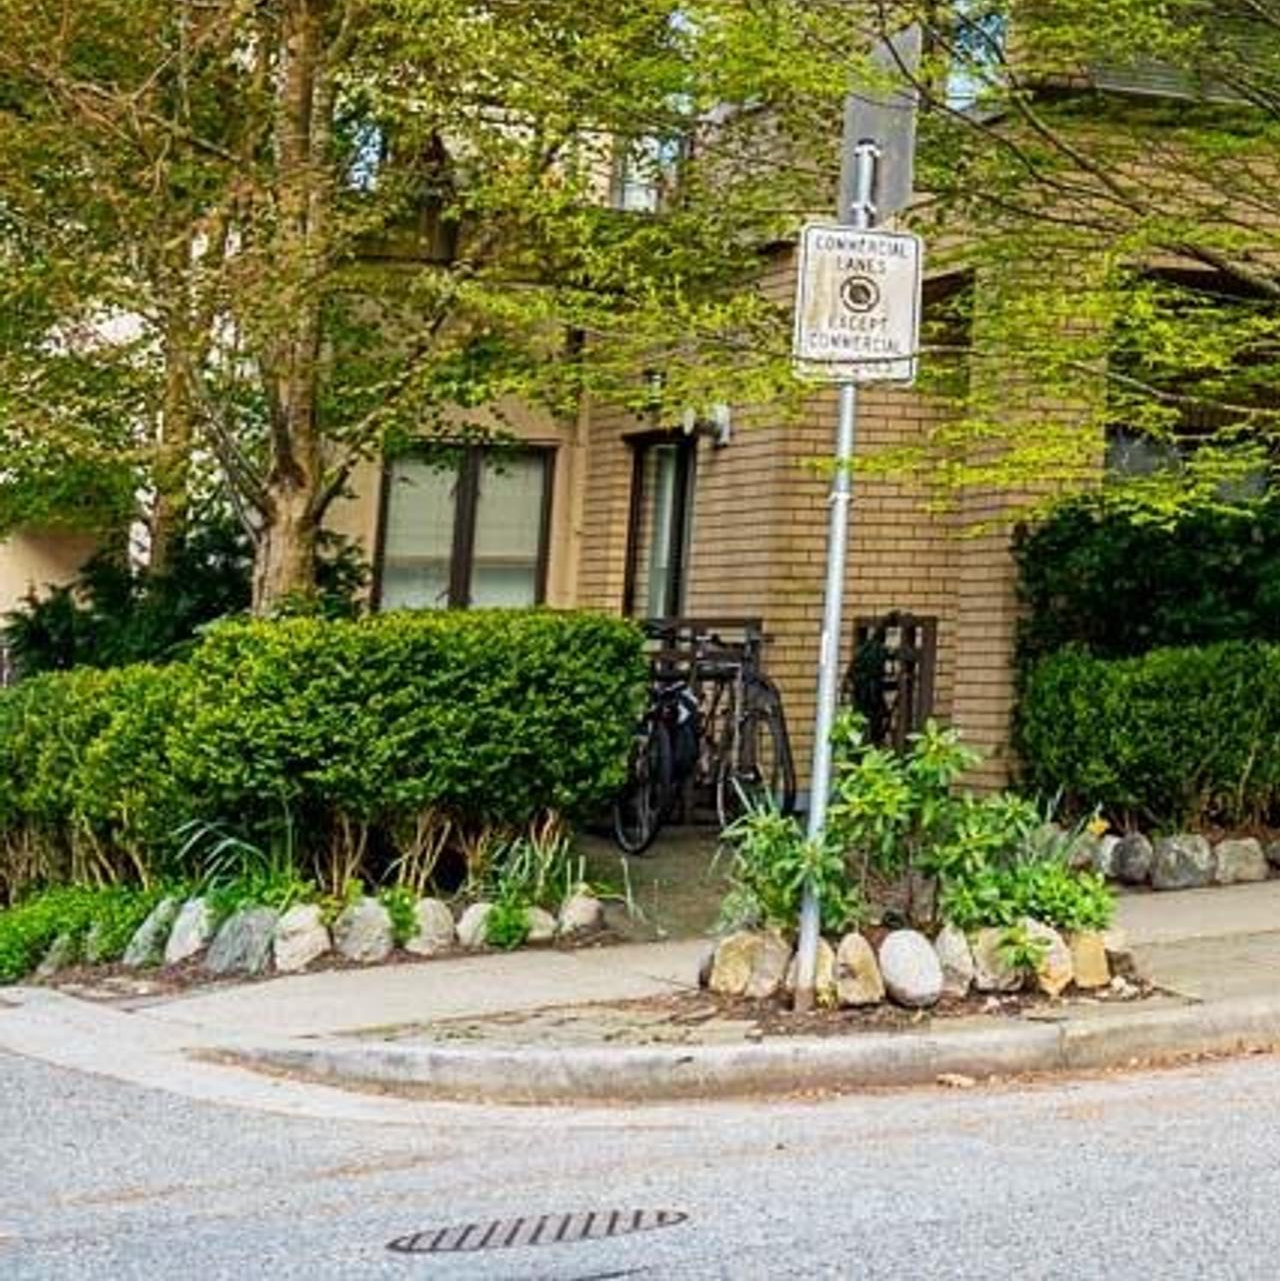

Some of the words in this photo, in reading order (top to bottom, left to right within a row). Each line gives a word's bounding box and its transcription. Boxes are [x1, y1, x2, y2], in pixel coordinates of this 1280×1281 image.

[816, 235, 908, 259] COMMERCIAL
[837, 255, 887, 274] LANES
[828, 315, 888, 332] EXCEPT
[809, 332, 901, 355] COMMERCIAL
